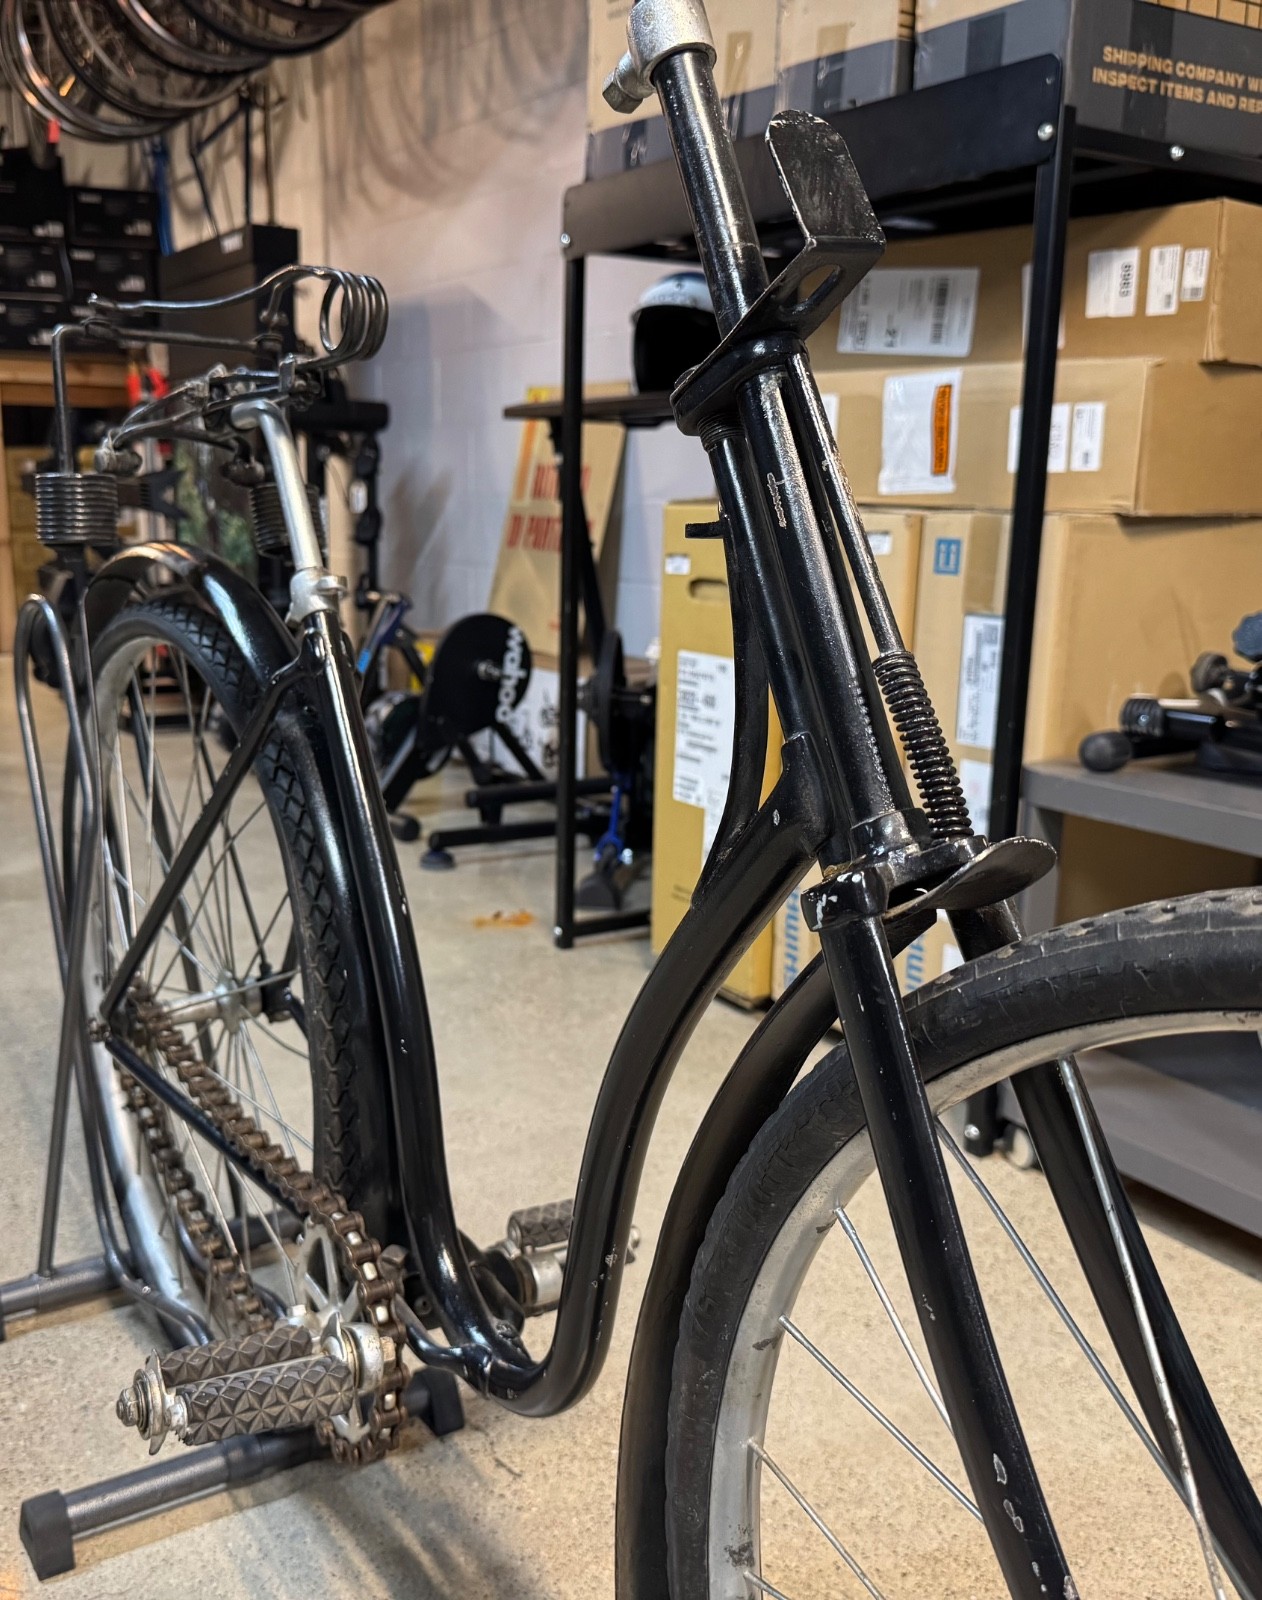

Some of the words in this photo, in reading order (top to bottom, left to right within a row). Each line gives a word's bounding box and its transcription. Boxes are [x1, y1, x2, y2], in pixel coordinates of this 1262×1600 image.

[1092, 67, 1158, 94] INSPECT
[1160, 81, 1204, 103] ITEMS
[1206, 89, 1238, 109] AND
[1103, 45, 1173, 74] SHIPPING
[1175, 61, 1246, 90] COMPANY
[495, 626, 527, 723] wahoo
